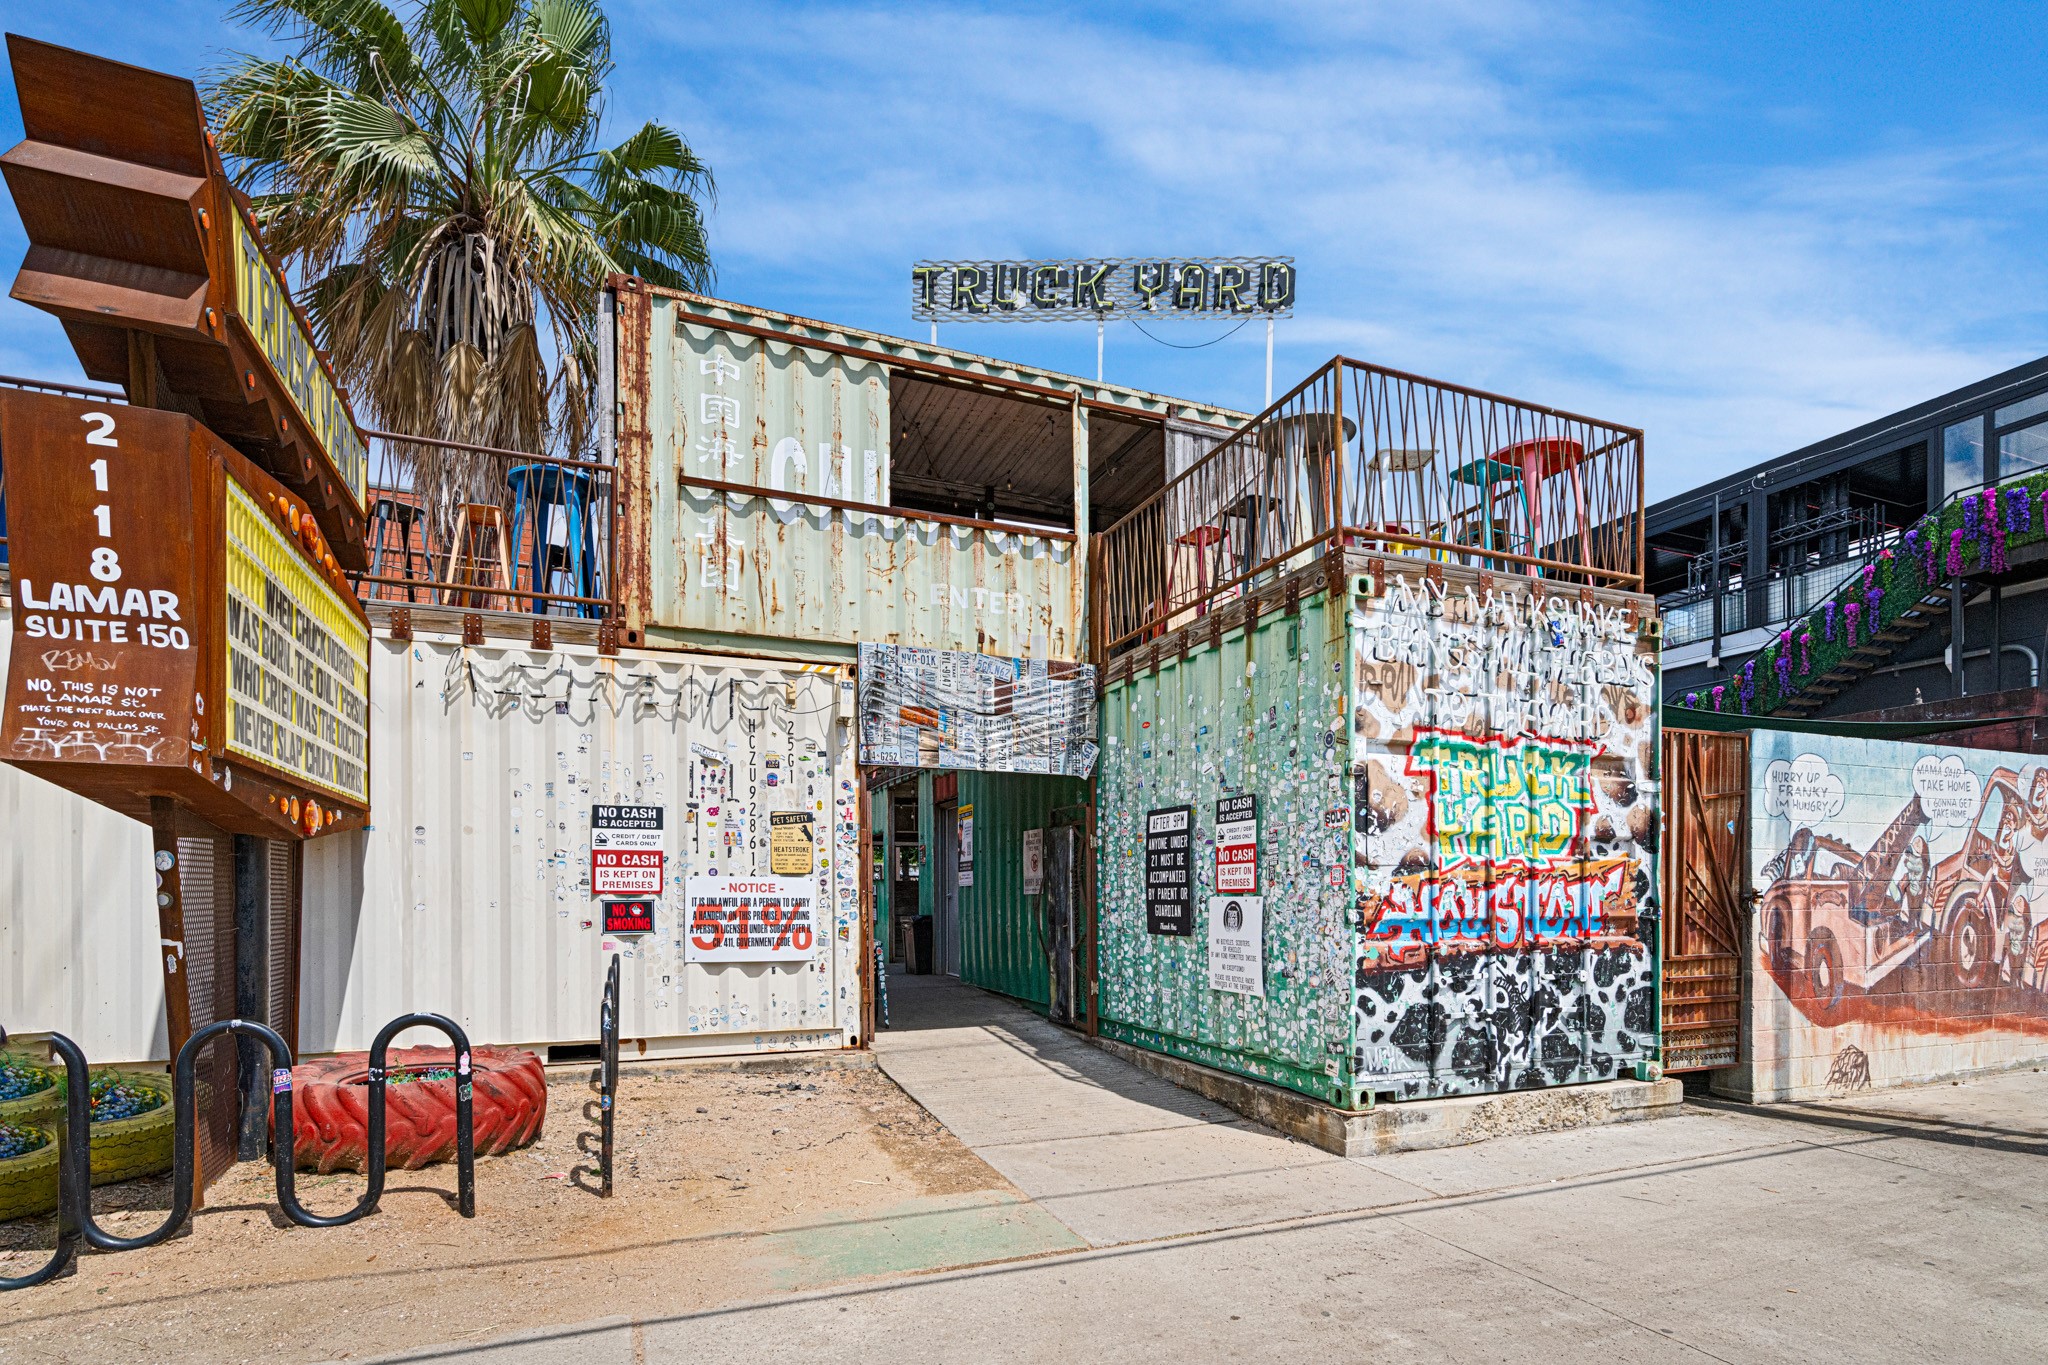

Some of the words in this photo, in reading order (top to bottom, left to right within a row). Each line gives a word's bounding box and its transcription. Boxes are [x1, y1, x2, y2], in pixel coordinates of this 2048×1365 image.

[912, 263, 1119, 313] TRUCK
[1134, 262, 1297, 313] YARD
[242, 226, 319, 430] TRUCK
[20, 579, 182, 621] LAMAR
[929, 583, 1025, 617] ENTER
[25, 615, 129, 643] SUITE
[137, 623, 190, 650] 150
[265, 576, 293, 639] WHEN
[296, 608, 327, 659] CHUCK
[328, 635, 355, 687] NORRIS
[228, 592, 260, 654] WAS
[262, 620, 294, 680] BORN,
[294, 648, 314, 695] THE
[316, 667, 339, 708] ONLY
[61, 681, 94, 694] THIS
[102, 684, 118, 695] IS
[124, 686, 162, 698] NOT
[231, 646, 260, 702] WHO
[263, 668, 292, 721] CRIED
[296, 690, 318, 737] WAS
[319, 708, 336, 744] THE
[46, 693, 113, 706] LAMAR
[56, 705, 73, 714] THE
[76, 707, 104, 715] NEXT
[105, 708, 136, 718] BLOCK
[138, 711, 167, 720] OVER
[72, 720, 91, 729] ON
[96, 721, 139, 731] DALLAS
[234, 701, 274, 758] NEVER
[277, 723, 303, 768] SLAP
[305, 741, 334, 783] CHUCK
[336, 754, 363, 795] NORRIS
[787, 720, 795, 784] 25G1
[1414, 740, 1590, 803] TRUCK
[1771, 770, 1803, 783] HURRY
[1807, 772, 1820, 783] UP
[1917, 764, 1942, 776] MAMA
[1943, 766, 1961, 778] SAID
[1779, 785, 1828, 798] FRANKY
[1920, 779, 1944, 792] TAKE
[1947, 780, 1971, 792] HOME
[1219, 800, 1230, 812] NO
[1232, 796, 1252, 810] CASH
[1933, 798, 1957, 807] GONNA
[1959, 798, 1973, 808] GET
[598, 807, 617, 818] NO
[621, 808, 656, 819] CASH
[772, 816, 784, 825] PET
[785, 814, 808, 823] SAFETY
[1219, 814, 1225, 822] IS
[1225, 810, 1253, 821] ACCEPTED
[1325, 809, 1347, 824] SOLR
[1932, 808, 1948, 819] TAKE
[1949, 808, 1967, 819] HOME
[598, 819, 608, 827] IS
[610, 820, 657, 828] ACCEPTED
[1152, 815, 1170, 831] AFTER
[1173, 813, 1185, 828] 9PM
[1437, 799, 1577, 866] YARD
[1148, 837, 1168, 851] ANYONE
[1170, 834, 1188, 849] UNDER
[597, 854, 617, 865] NO
[621, 854, 659, 866] CASH
[1151, 855, 1158, 867] 21
[1160, 853, 1174, 866] MUST
[1176, 853, 1184, 866] BE
[1218, 850, 1230, 862] NO
[1232, 848, 1254, 861] CASH
[599, 870, 609, 878] IS
[613, 870, 638, 878] KEPT
[642, 871, 656, 879] ON
[1150, 870, 1186, 884] ACCOMPANIED
[1220, 868, 1226, 876] IS
[1227, 867, 1242, 876] KEPT
[1243, 866, 1252, 875] ON
[602, 881, 653, 889] PREMISES
[728, 882, 776, 893] NOTICE
[1221, 878, 1251, 887] PREMISES
[1148, 888, 1155, 900] BY
[1157, 887, 1178, 900] PARENT
[1180, 887, 1188, 900] OR
[691, 897, 697, 907] IT
[699, 897, 705, 907] IS
[706, 897, 738, 907] UNLAWFUL
[740, 897, 751, 907] FOR
[753, 897, 758, 907] A
[758, 897, 780, 907] PERSON
[783, 898, 790, 907] TO
[791, 897, 810, 908] CARRY
[612, 903, 626, 917] NO
[692, 911, 697, 921] A
[698, 911, 727, 921] HANDGUN
[728, 911, 737, 921] ON
[739, 911, 752, 921] THIS
[780, 911, 810, 921] INCLUDING
[1155, 904, 1182, 918] GUARDIAN
[607, 917, 651, 931] SMOKING
[690, 924, 695, 934] A
[696, 924, 719, 934] PERSON
[720, 924, 748, 934] LICENSED
[749, 924, 768, 934] UNDER
[769, 924, 805, 934] SUBCHAPTER
[691, 901, 813, 951] 51%
[736, 937, 775, 948] GOVERNMENT
[776, 937, 791, 947] CODE
